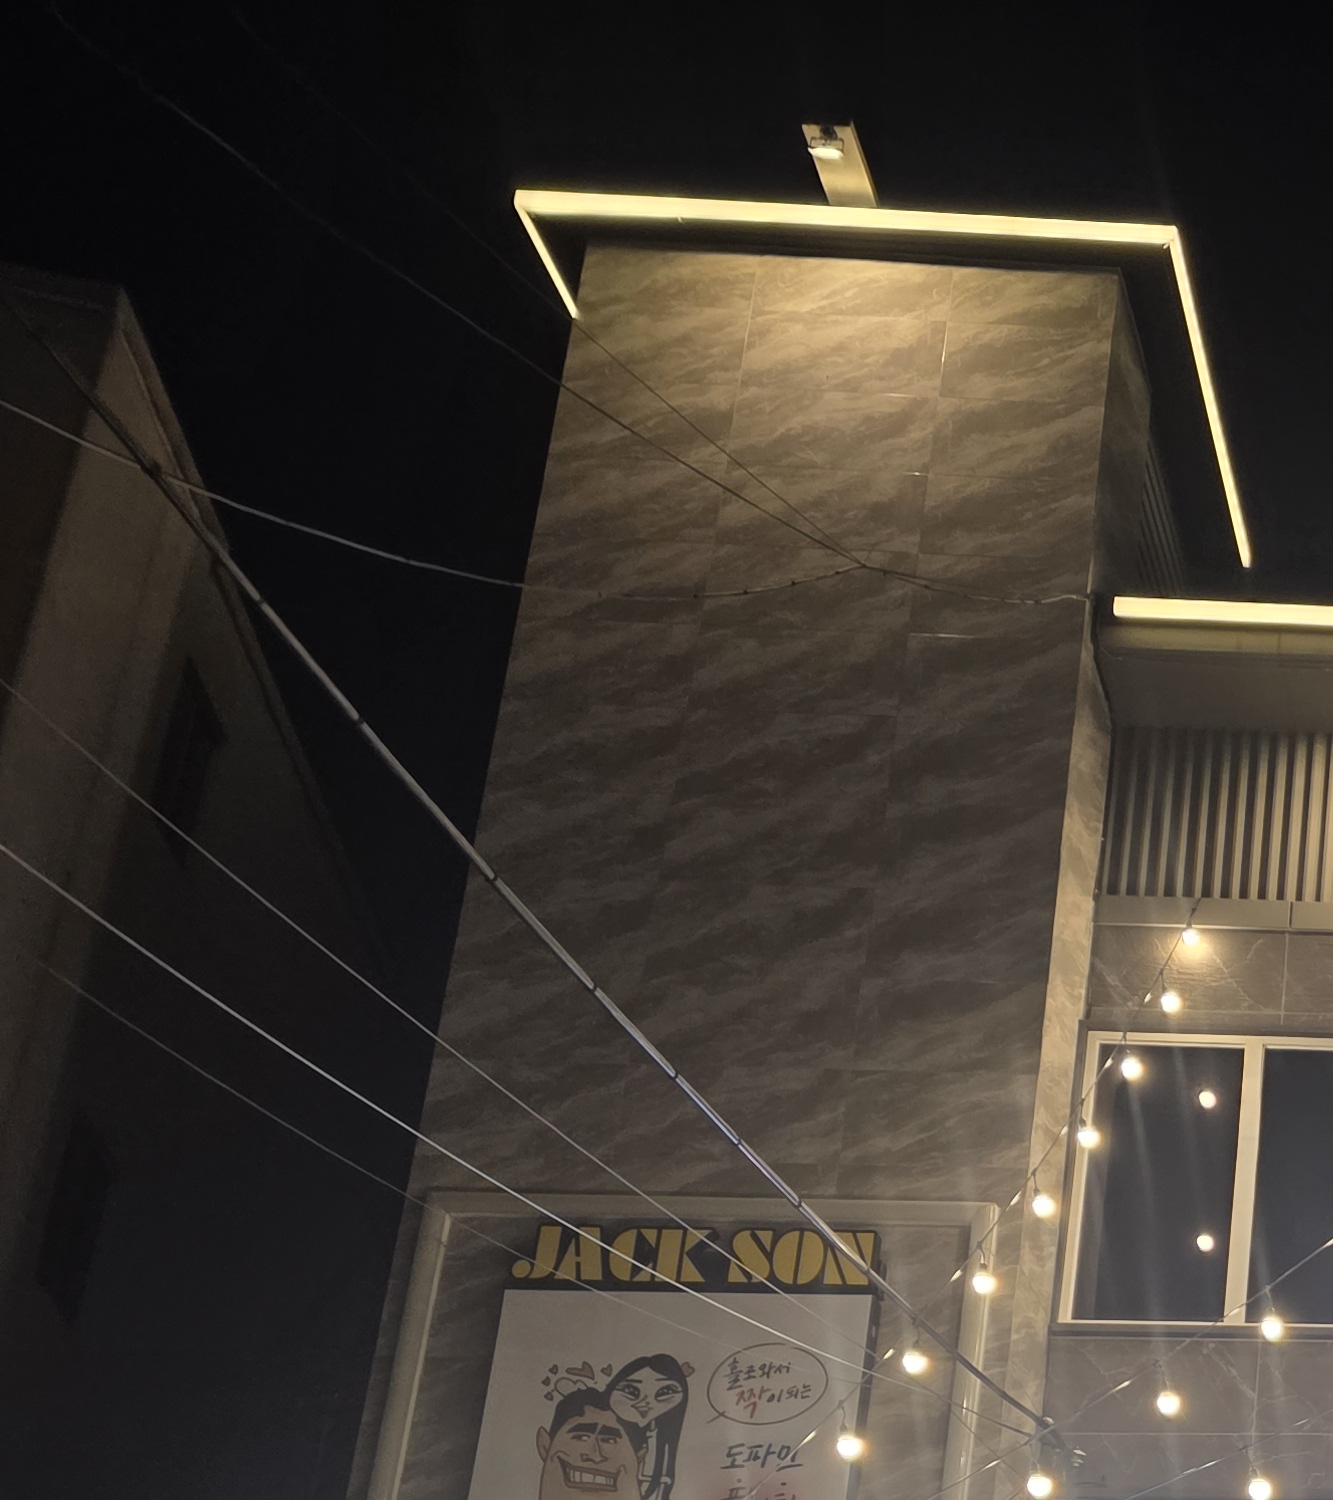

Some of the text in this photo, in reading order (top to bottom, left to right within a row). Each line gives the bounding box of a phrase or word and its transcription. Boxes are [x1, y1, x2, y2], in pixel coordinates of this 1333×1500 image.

[511, 1225, 876, 1286] JACK SON
[720, 1442, 803, 1472] 도파민
